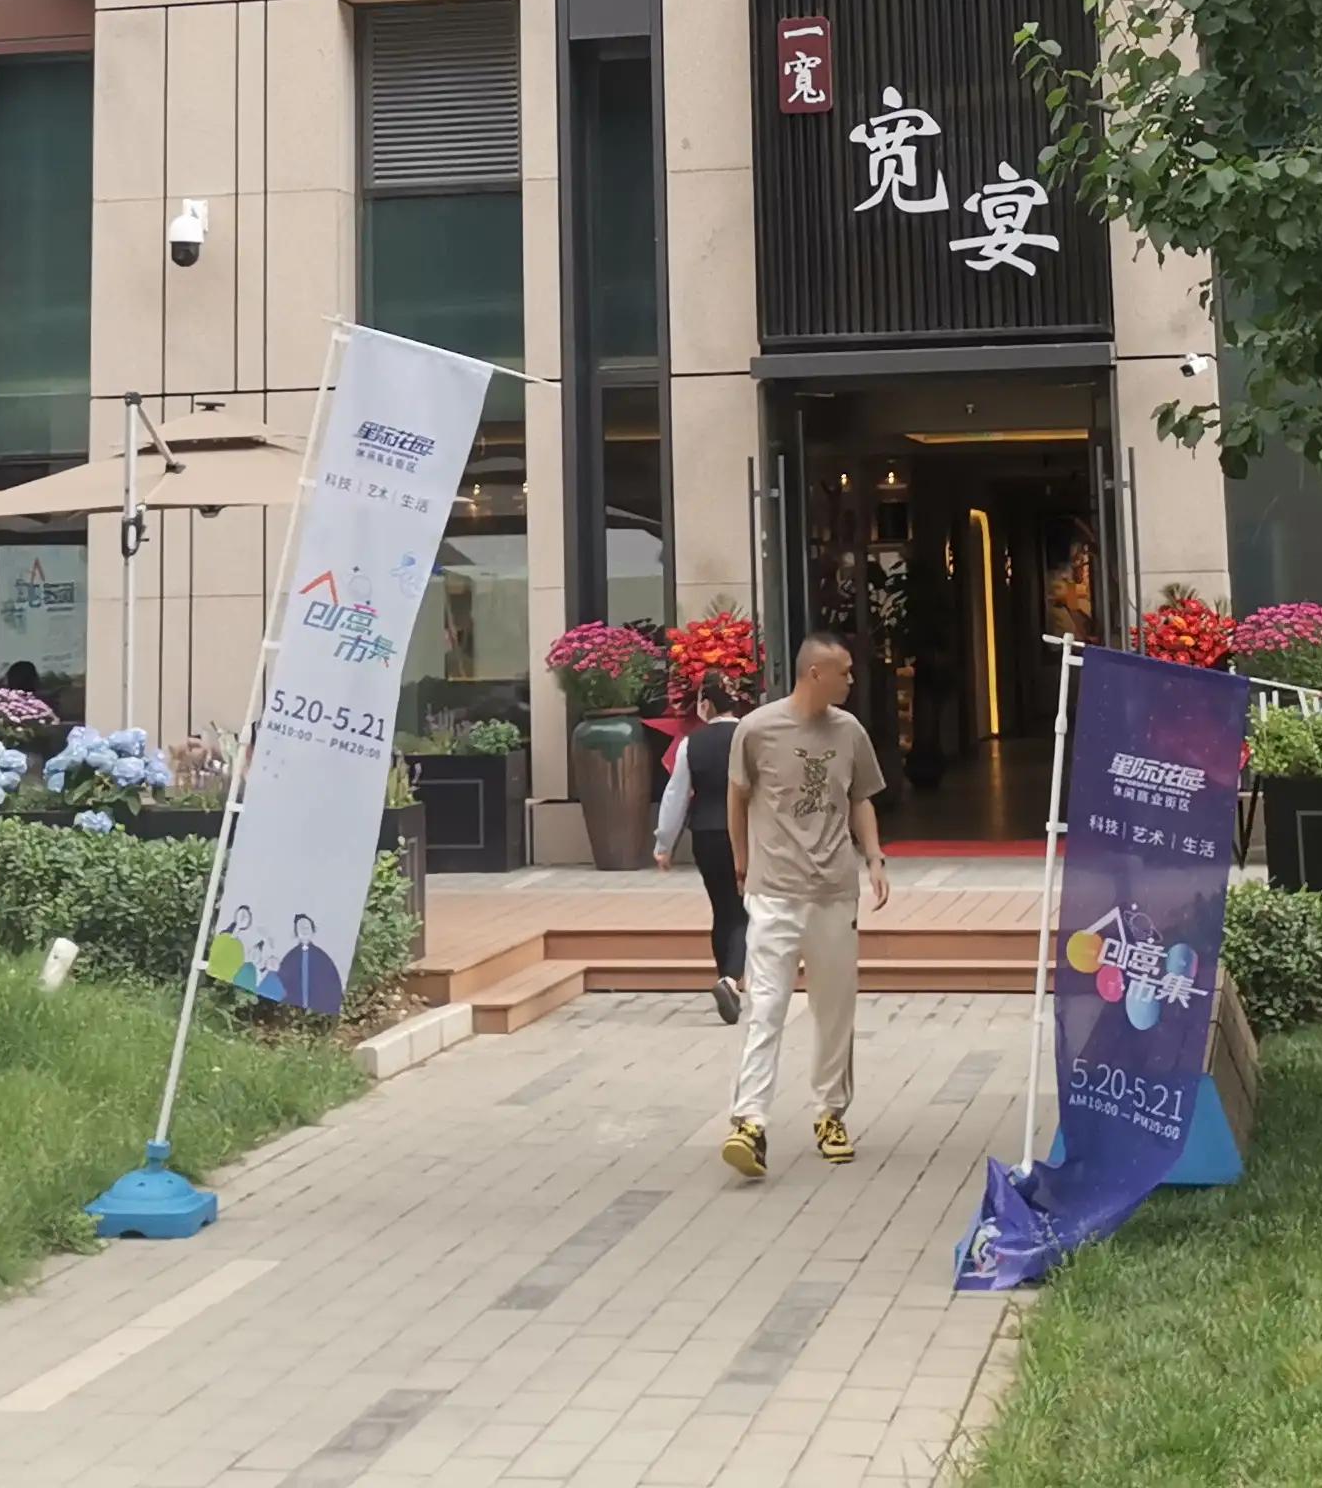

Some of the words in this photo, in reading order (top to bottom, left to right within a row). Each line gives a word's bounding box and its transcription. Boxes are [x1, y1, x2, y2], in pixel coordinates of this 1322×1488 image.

[848, 86, 1060, 277] 宽宴
[271, 689, 385, 742] 5.20-5.21
[1107, 752, 1207, 792] 星际花园
[1070, 1057, 1183, 1123] 5.20-5.21
